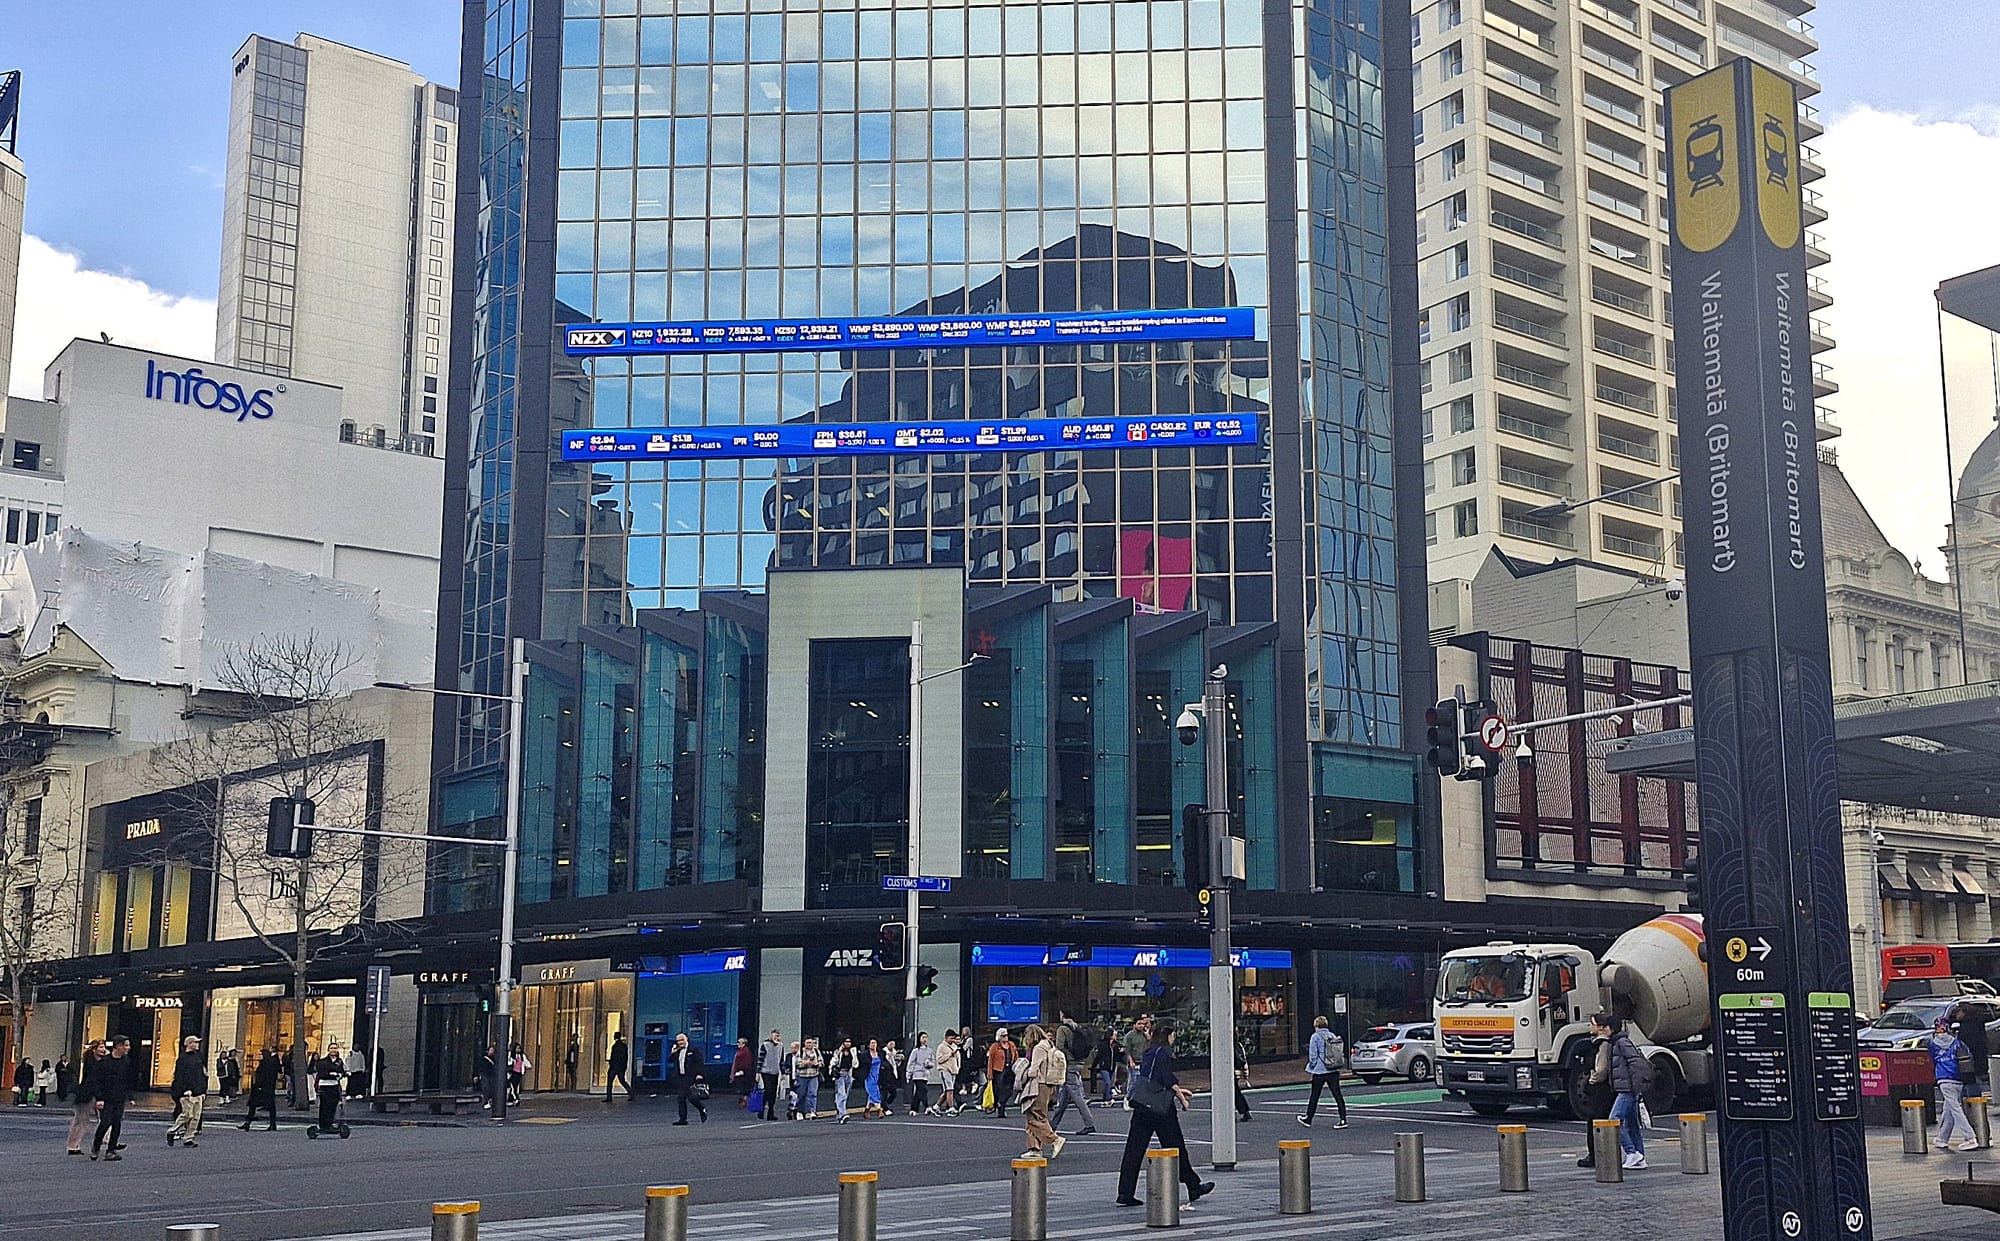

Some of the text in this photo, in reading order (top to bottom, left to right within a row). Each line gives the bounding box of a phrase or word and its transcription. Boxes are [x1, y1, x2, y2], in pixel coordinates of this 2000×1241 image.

[849, 325, 871, 333] WMP
[918, 323, 939, 332] WMP
[986, 321, 1008, 330] WMP
[632, 330, 653, 338] NZ10
[703, 328, 725, 336] NZ20
[774, 327, 796, 335] NZ50
[570, 332, 608, 345] NZX
[146, 360, 273, 421] Infosys
[1194, 421, 1211, 430] EUR
[1701, 270, 1736, 573] Waitematā (Britomart)
[1775, 272, 1805, 570] Waitematā (Britomart)
[1063, 425, 1082, 433] AUD
[1128, 423, 1147, 431] CAD
[817, 431, 833, 439] FPH
[897, 430, 915, 438] GMT
[920, 429, 944, 437] $2.02
[981, 428, 994, 436] IFT
[652, 435, 664, 443] IPL
[733, 437, 747, 445] IPR
[753, 433, 778, 441] $0.00
[570, 440, 585, 449] INF
[126, 818, 161, 840] PRADA
[270, 867, 297, 900] Dio
[887, 878, 917, 888] CUSTOMS
[724, 956, 744, 970] ANZ
[824, 949, 873, 968] ANZ
[1133, 953, 1158, 966] ANZ
[420, 973, 468, 983] GRAFF
[541, 967, 575, 980] GRAFF
[1736, 968, 1764, 981] 60m
[136, 997, 183, 1007] PRADA
